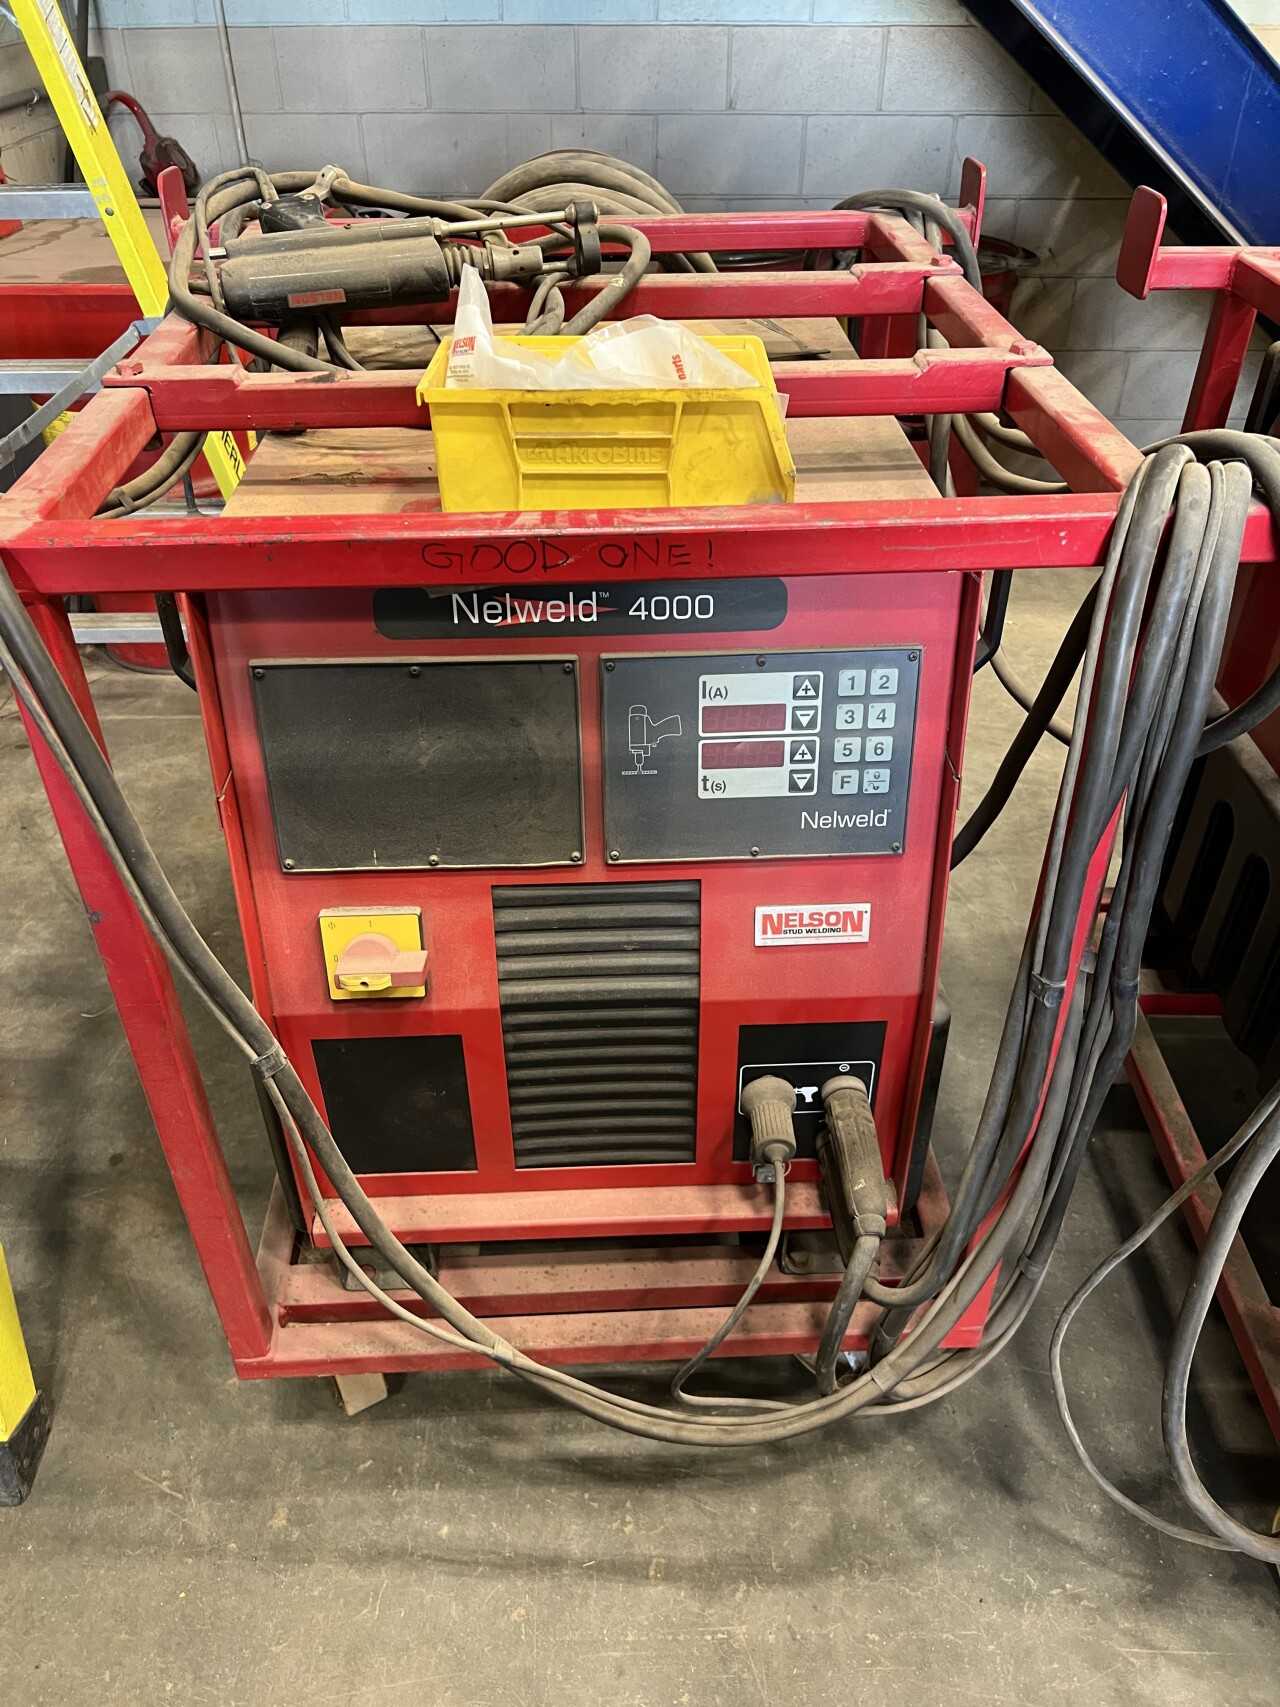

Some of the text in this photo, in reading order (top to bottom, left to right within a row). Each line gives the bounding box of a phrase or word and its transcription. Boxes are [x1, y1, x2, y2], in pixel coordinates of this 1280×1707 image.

[421, 538, 714, 574] GOOD ONE!
[628, 594, 714, 621] 4000
[847, 674, 891, 691] 1 2
[844, 708, 887, 724] 3 4
[842, 741, 885, 757] 5 6
[840, 775, 852, 790] F
[761, 910, 864, 935] NELSON
